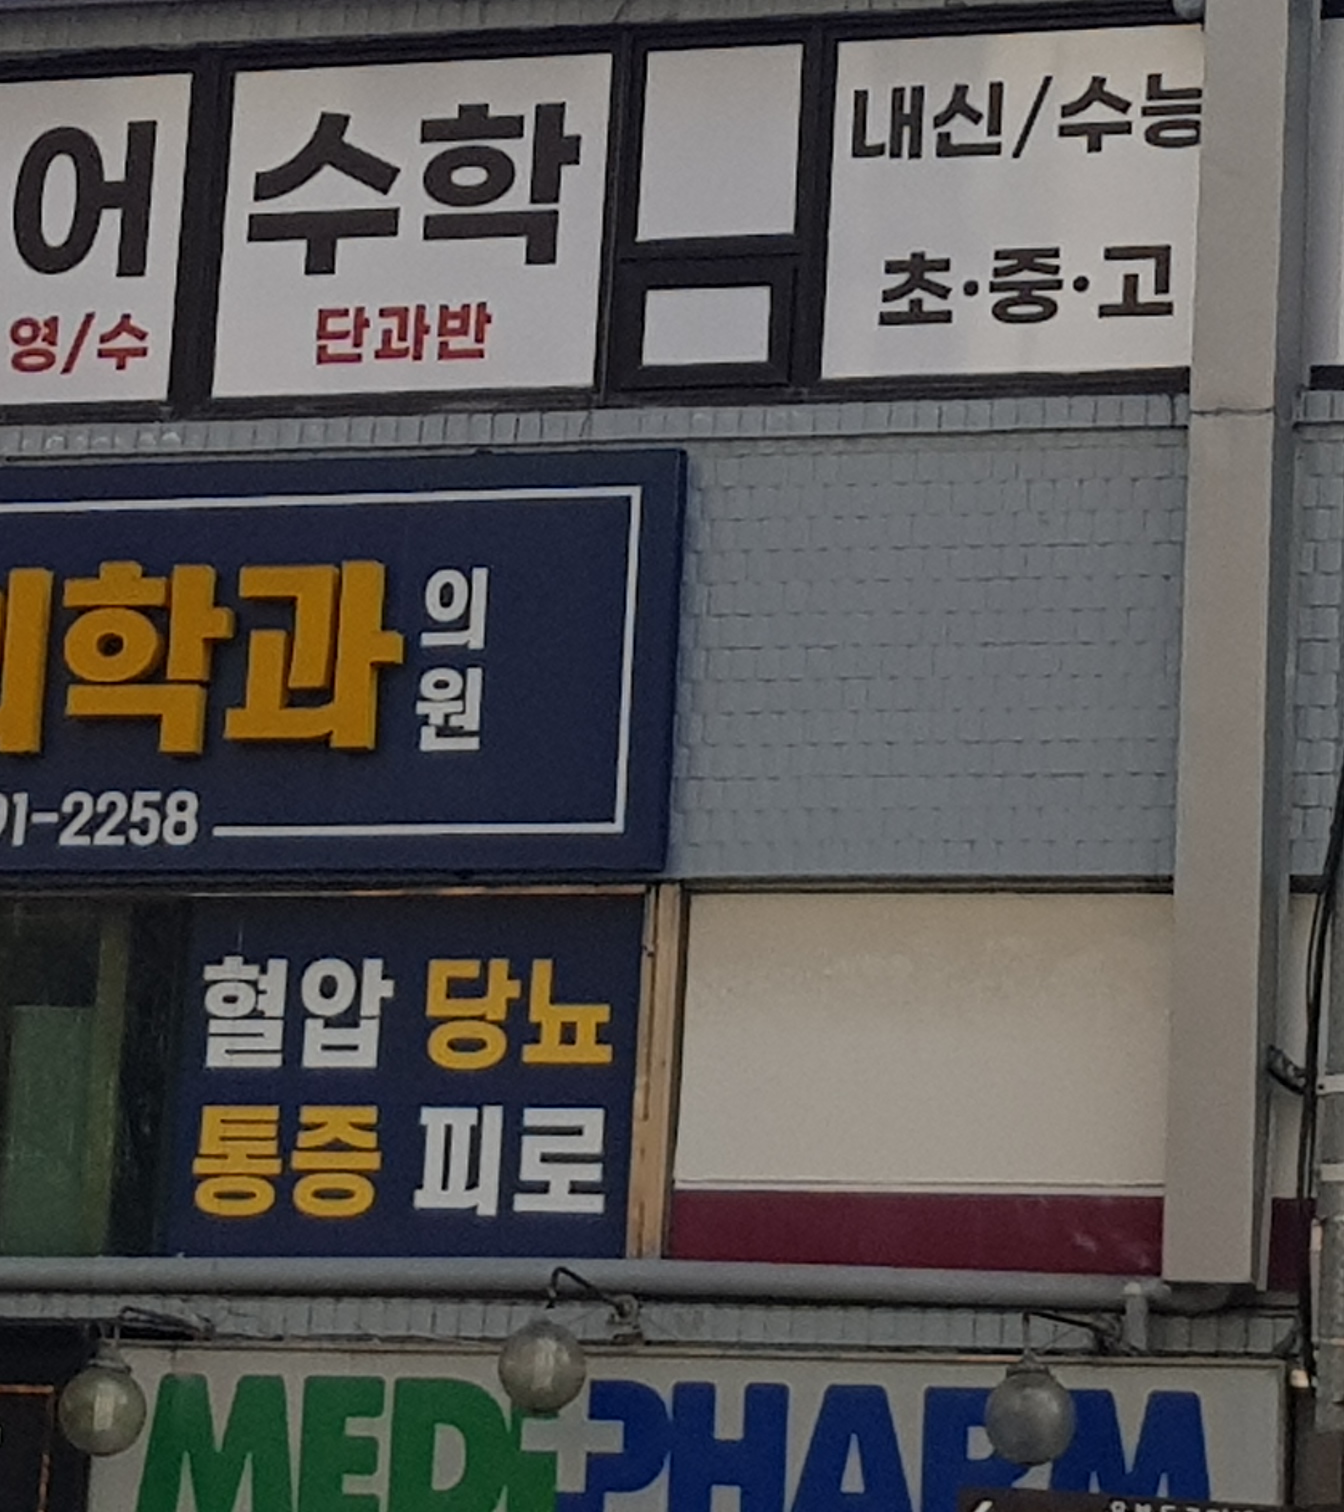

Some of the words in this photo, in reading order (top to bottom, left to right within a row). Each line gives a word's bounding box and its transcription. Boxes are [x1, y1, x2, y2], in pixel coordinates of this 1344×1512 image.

[851, 73, 1203, 160] 내신/수능
[246, 101, 582, 276] 수학
[8, 311, 150, 375] 영/수
[314, 301, 493, 367] 단과반
[203, 954, 395, 1068] 혈압
[425, 957, 613, 1071] 당뇨
[192, 1104, 382, 1218] 통증
[413, 1105, 606, 1217] 피로
